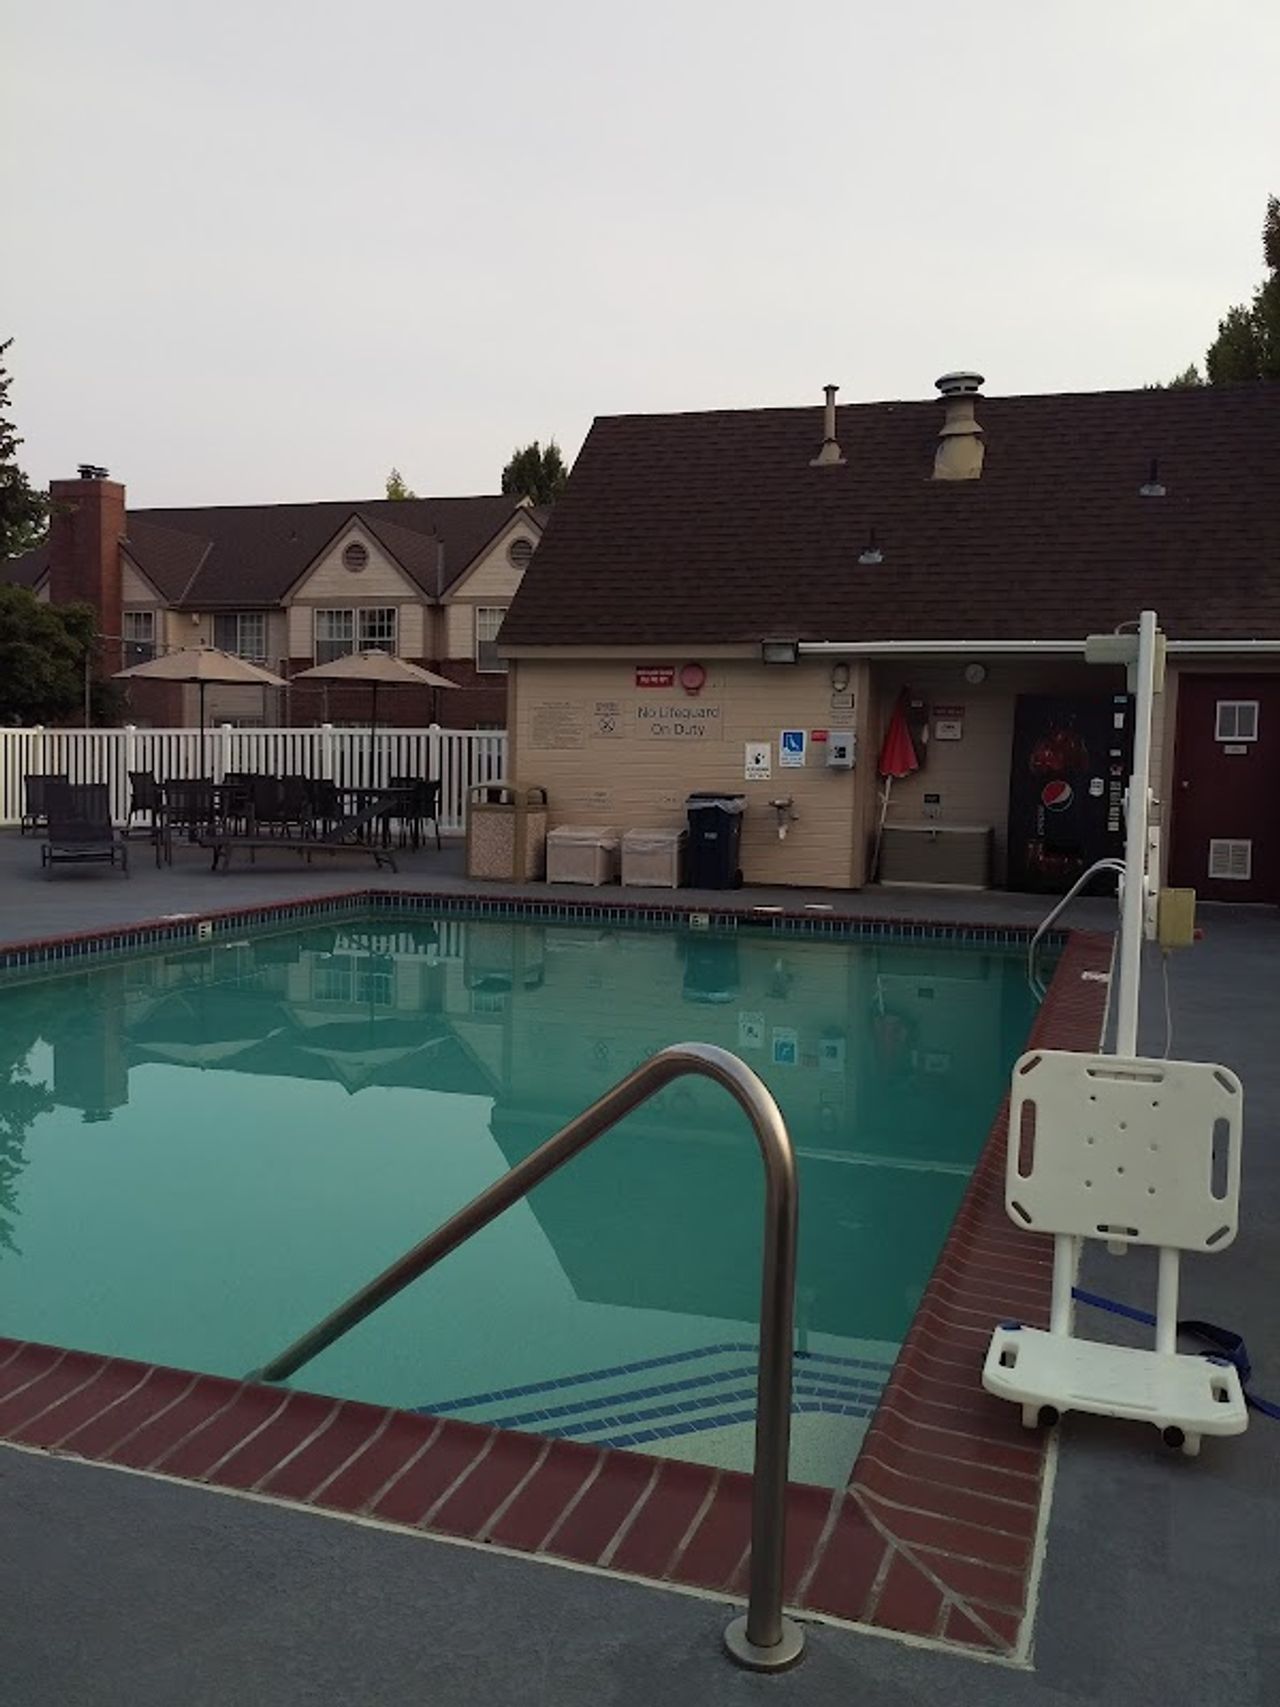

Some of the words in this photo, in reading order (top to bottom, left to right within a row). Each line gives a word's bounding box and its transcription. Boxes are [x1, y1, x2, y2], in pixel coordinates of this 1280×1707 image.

[638, 706, 656, 719] No
[659, 706, 720, 720] Lifeguard
[651, 723, 670, 736] On
[674, 723, 705, 737] Duty
